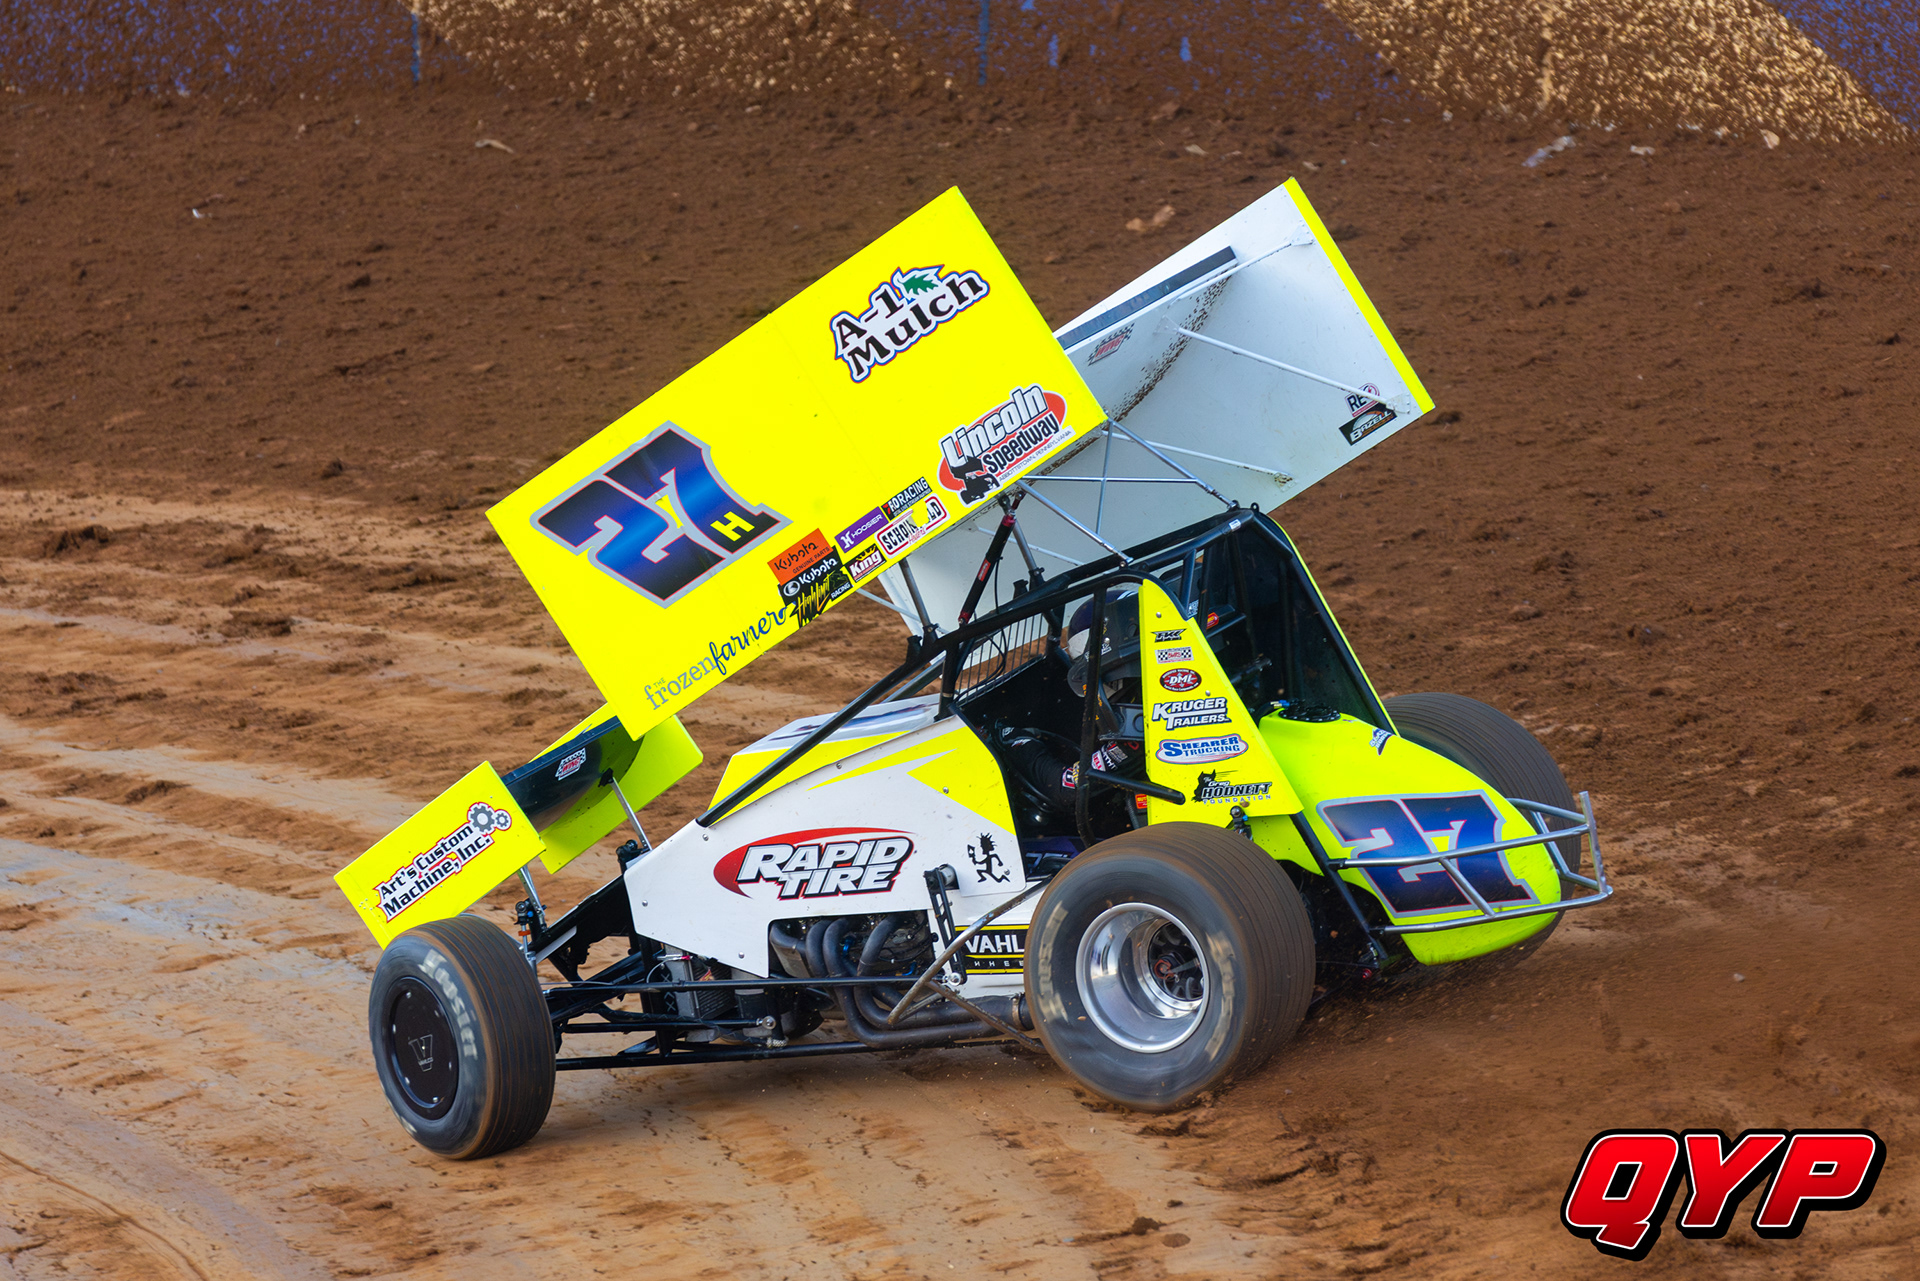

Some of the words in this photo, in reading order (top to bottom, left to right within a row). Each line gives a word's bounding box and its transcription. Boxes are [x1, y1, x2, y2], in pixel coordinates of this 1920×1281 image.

[836, 289, 904, 350] A-1
[846, 276, 984, 377] Mulch
[940, 385, 1049, 468] Lincoln
[982, 411, 1060, 474] Speedway
[850, 513, 883, 538] HOOSIER
[774, 541, 819, 571] Kubota
[792, 556, 814, 574] GENUINE
[812, 545, 831, 560] PARTS
[798, 556, 838, 585] Kubota
[850, 550, 882, 577] King
[830, 582, 851, 599] RACING
[652, 677, 667, 689] THE
[1169, 674, 1192, 684] DMI
[1152, 696, 1227, 721] KRUGER
[1166, 712, 1226, 730] TRAILERS
[1162, 736, 1239, 757] SHEARER
[1182, 744, 1241, 757] TRUCKING
[1201, 781, 1273, 799] HODNETT
[1202, 794, 1272, 805] FOUNDATION
[380, 867, 418, 900] Art's
[415, 825, 474, 871] Custom
[735, 836, 914, 883] RAPID
[1319, 791, 1536, 916] 27
[383, 860, 460, 917] Machine,
[456, 836, 491, 861] Inc.
[779, 864, 898, 898] TIRE
